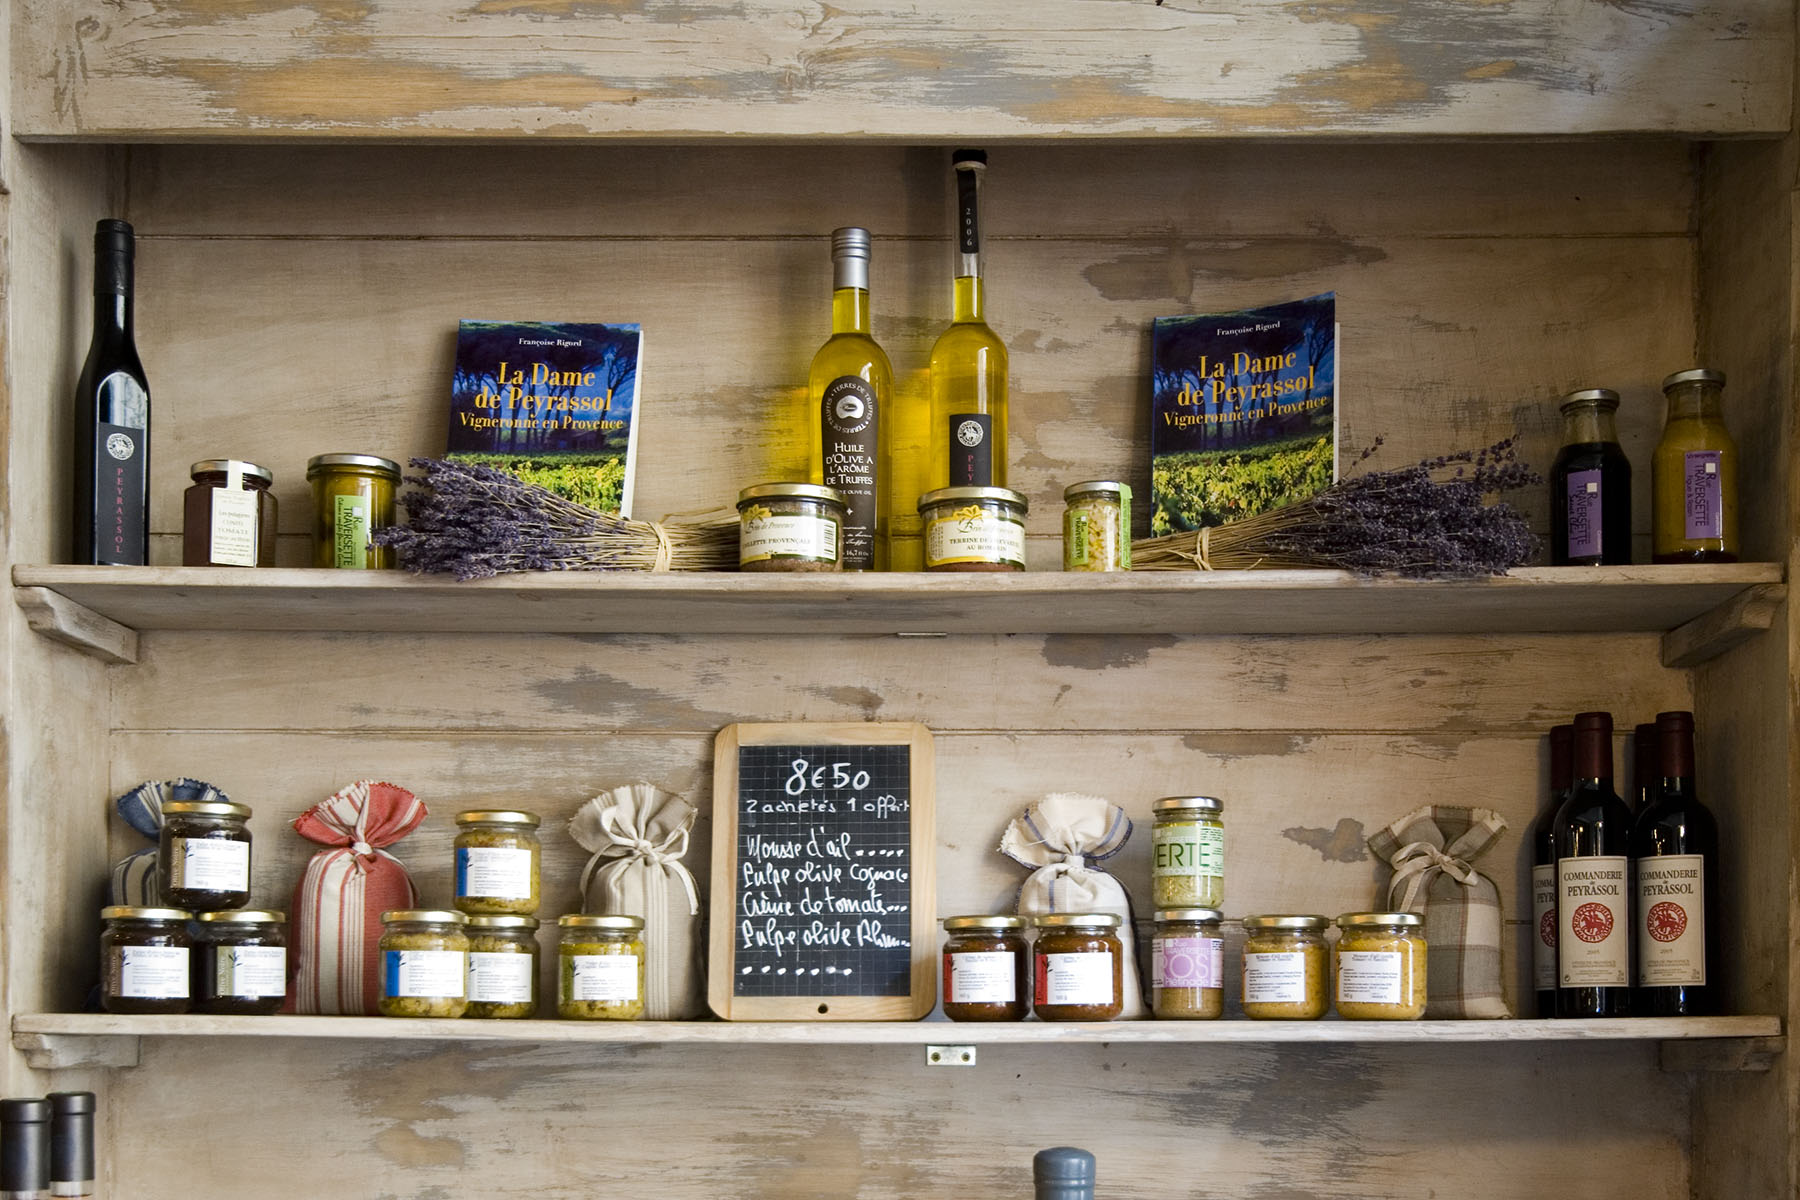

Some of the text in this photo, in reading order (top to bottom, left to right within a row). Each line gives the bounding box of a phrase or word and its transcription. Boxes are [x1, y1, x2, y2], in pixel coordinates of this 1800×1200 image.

[965, 207, 973, 246] 2006
[1216, 320, 1281, 336] Françoise Rigord
[518, 337, 582, 347] Françoise Rigord
[497, 362, 596, 386] La Dame
[1199, 351, 1297, 379] La Dame
[1177, 365, 1314, 411] de Peyrassol
[475, 385, 613, 418] de Peyrassol
[1163, 395, 1327, 431] Vigneronne en Provence
[460, 412, 624, 431] Vigneronne en Provence
[834, 441, 865, 453] HUILE
[826, 453, 864, 465] D'OLIVE
[829, 463, 870, 474] L'ARÔME
[967, 454, 975, 487] PEY
[826, 473, 873, 485] DE TRUFFES
[1694, 463, 1706, 527] TRAVERSETTE
[114, 467, 124, 553] PEYRASSOL
[1576, 483, 1588, 546] TRAVERSETTE
[344, 507, 353, 566] TRAVERSETTE
[746, 799, 758, 813] 2
[763, 798, 837, 814] achetés
[847, 797, 857, 813] 1
[795, 861, 842, 884] olive
[1563, 870, 1623, 882] COMMANDERIE
[1639, 869, 1698, 881] COMMANDERIE
[800, 886, 824, 914] de
[1567, 884, 1620, 897] PEYRASSOL
[1642, 883, 1694, 896] PEYRASSOL
[803, 920, 852, 947] olive
